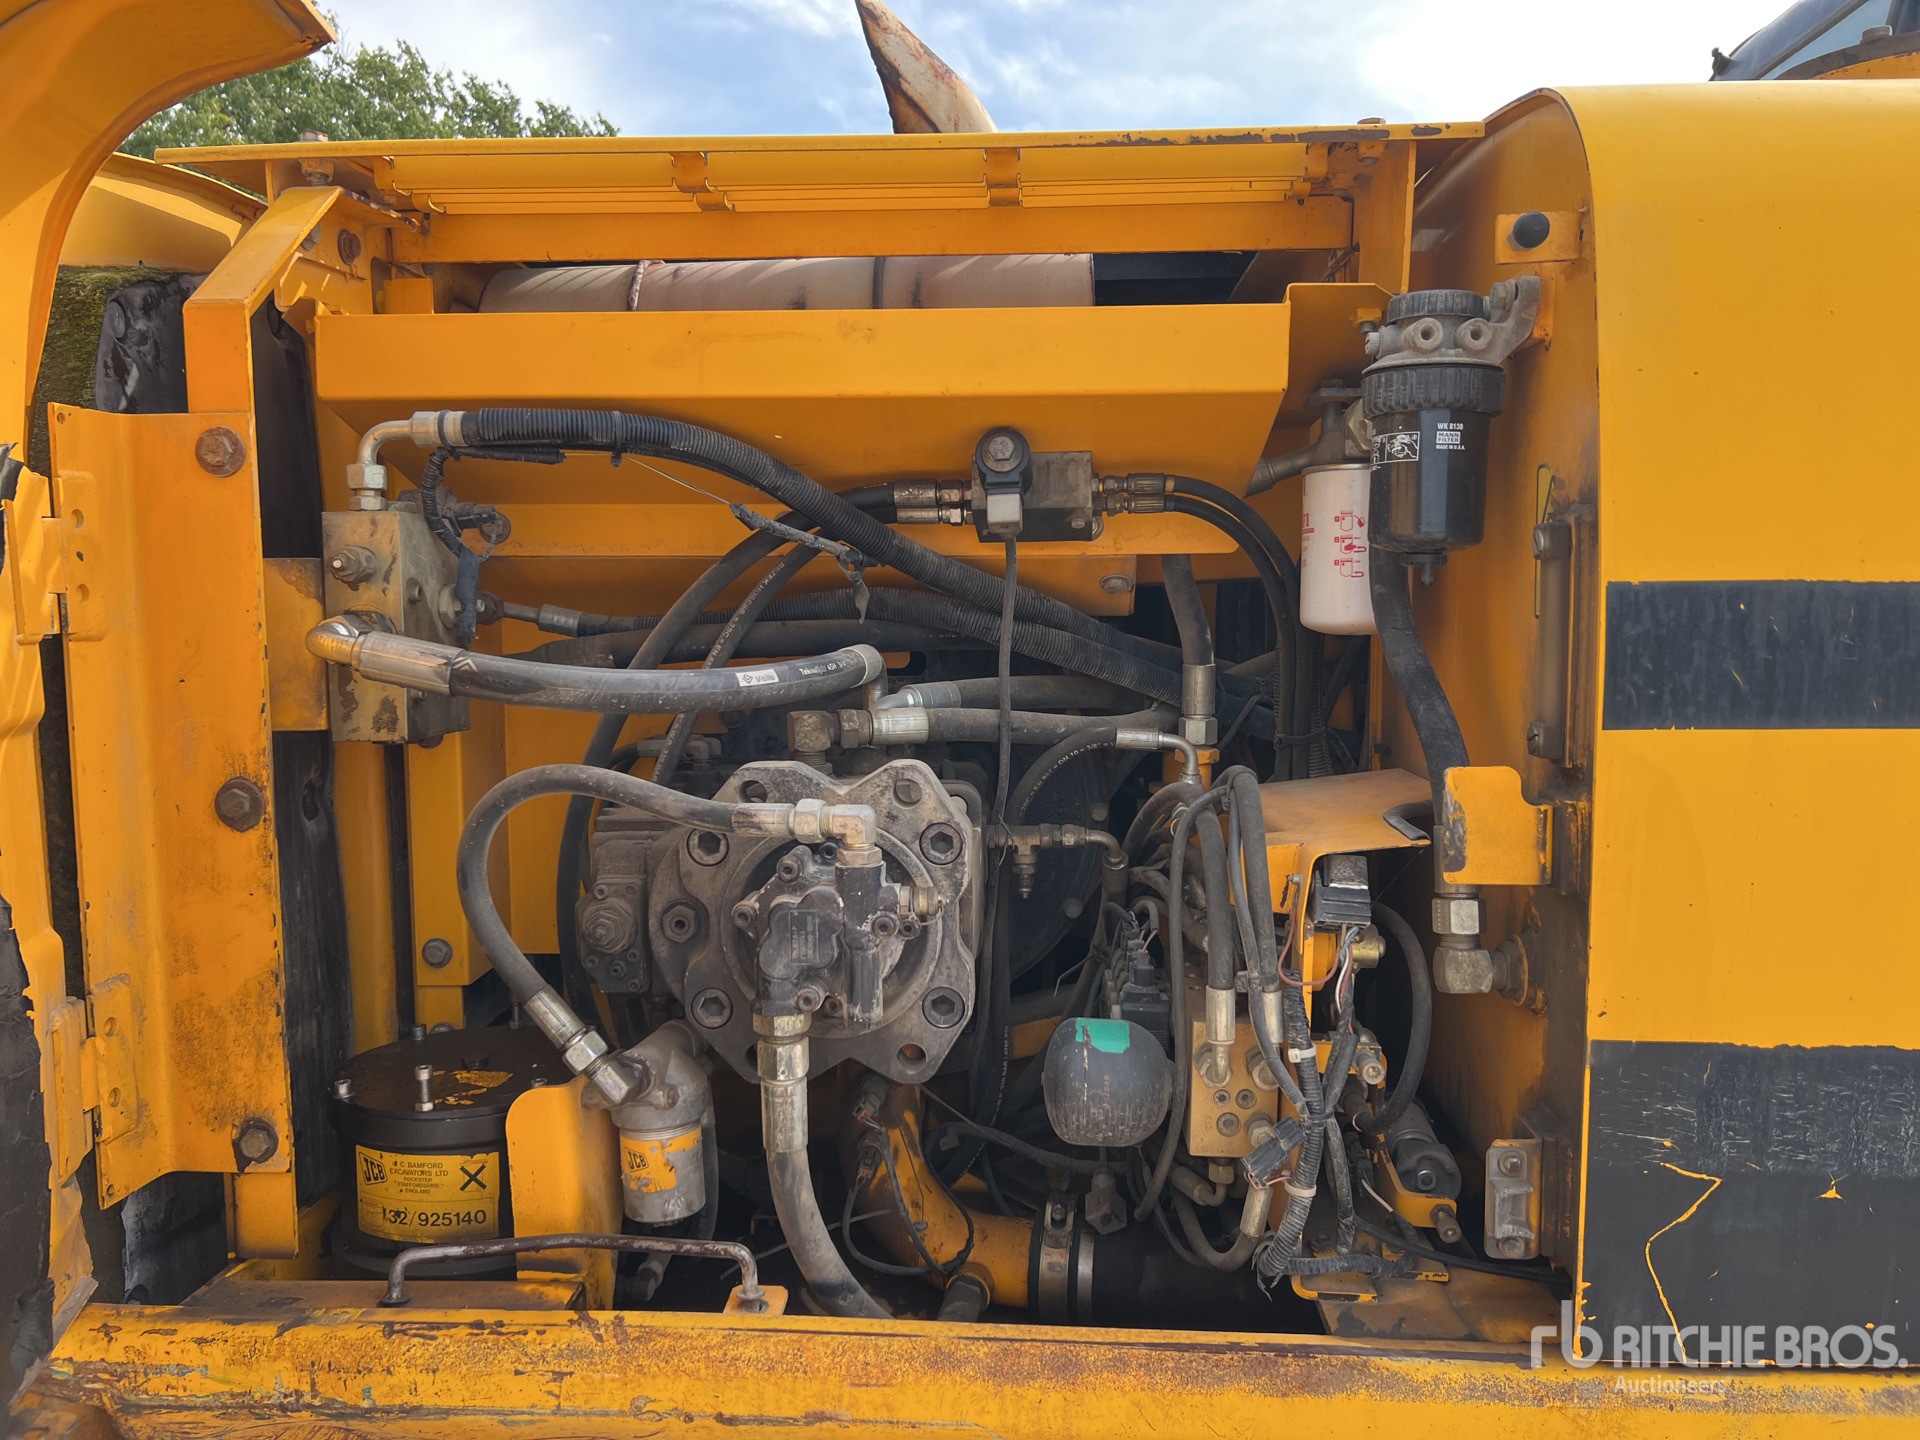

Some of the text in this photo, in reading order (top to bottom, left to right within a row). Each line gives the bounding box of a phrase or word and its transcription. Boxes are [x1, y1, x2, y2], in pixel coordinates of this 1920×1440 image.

[1437, 422, 1449, 430] WK
[712, 644, 722, 656] EN
[1058, 755, 1069, 765] DN
[1069, 749, 1079, 757] 10
[627, 1151, 647, 1169] JCB
[363, 1157, 386, 1182] JCB
[389, 1168, 432, 1177] EXCAVATORS
